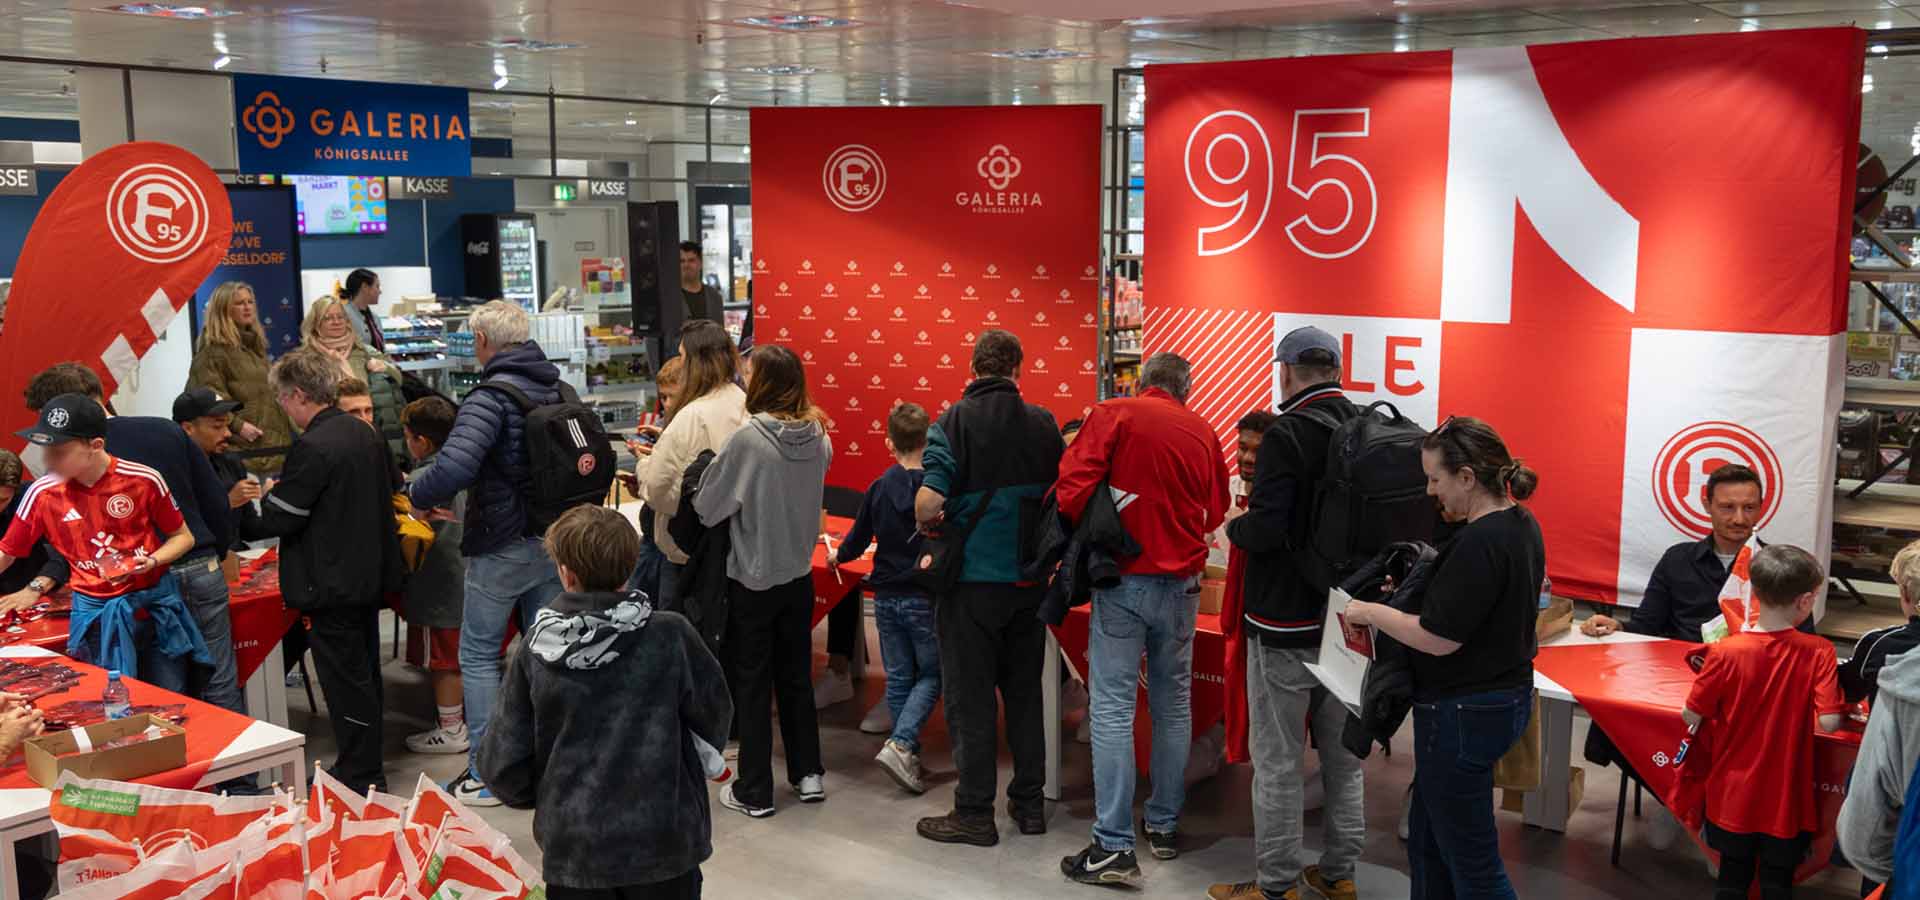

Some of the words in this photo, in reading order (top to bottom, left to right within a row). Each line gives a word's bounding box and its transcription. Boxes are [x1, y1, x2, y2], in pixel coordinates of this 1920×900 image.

[310, 108, 465, 140] GALERIA
[314, 147, 409, 161] KÖNIGSALLEE
[406, 178, 449, 193] KASSE
[591, 181, 626, 196] KASSE
[854, 183, 870, 196] 95
[1184, 107, 1377, 259] 95
[955, 191, 1043, 207] GALERIA
[157, 223, 182, 242] 95
[222, 252, 287, 265] SSELDORF
[1342, 332, 1425, 397] LE
[1192, 671, 1225, 684] GALERI
